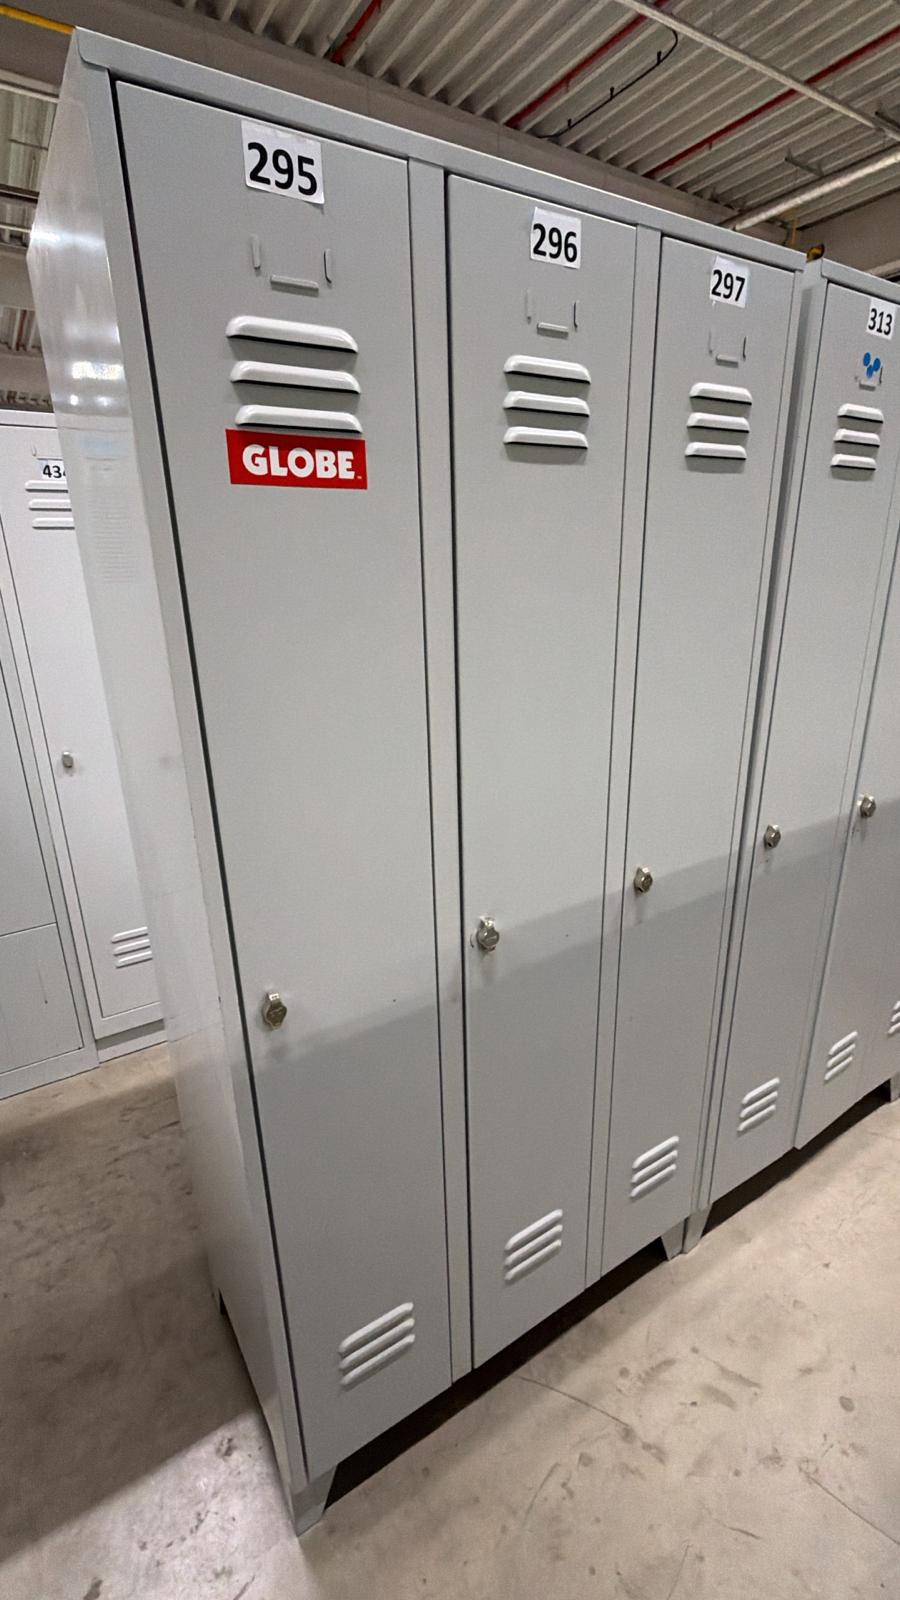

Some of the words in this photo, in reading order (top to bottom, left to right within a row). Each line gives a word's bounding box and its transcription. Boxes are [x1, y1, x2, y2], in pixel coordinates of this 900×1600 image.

[247, 141, 318, 196] 295
[532, 223, 578, 263] 296
[711, 269, 746, 302] 297
[867, 307, 893, 336] 313
[42, 464, 66, 479] 43
[242, 443, 356, 480] GLOBE
